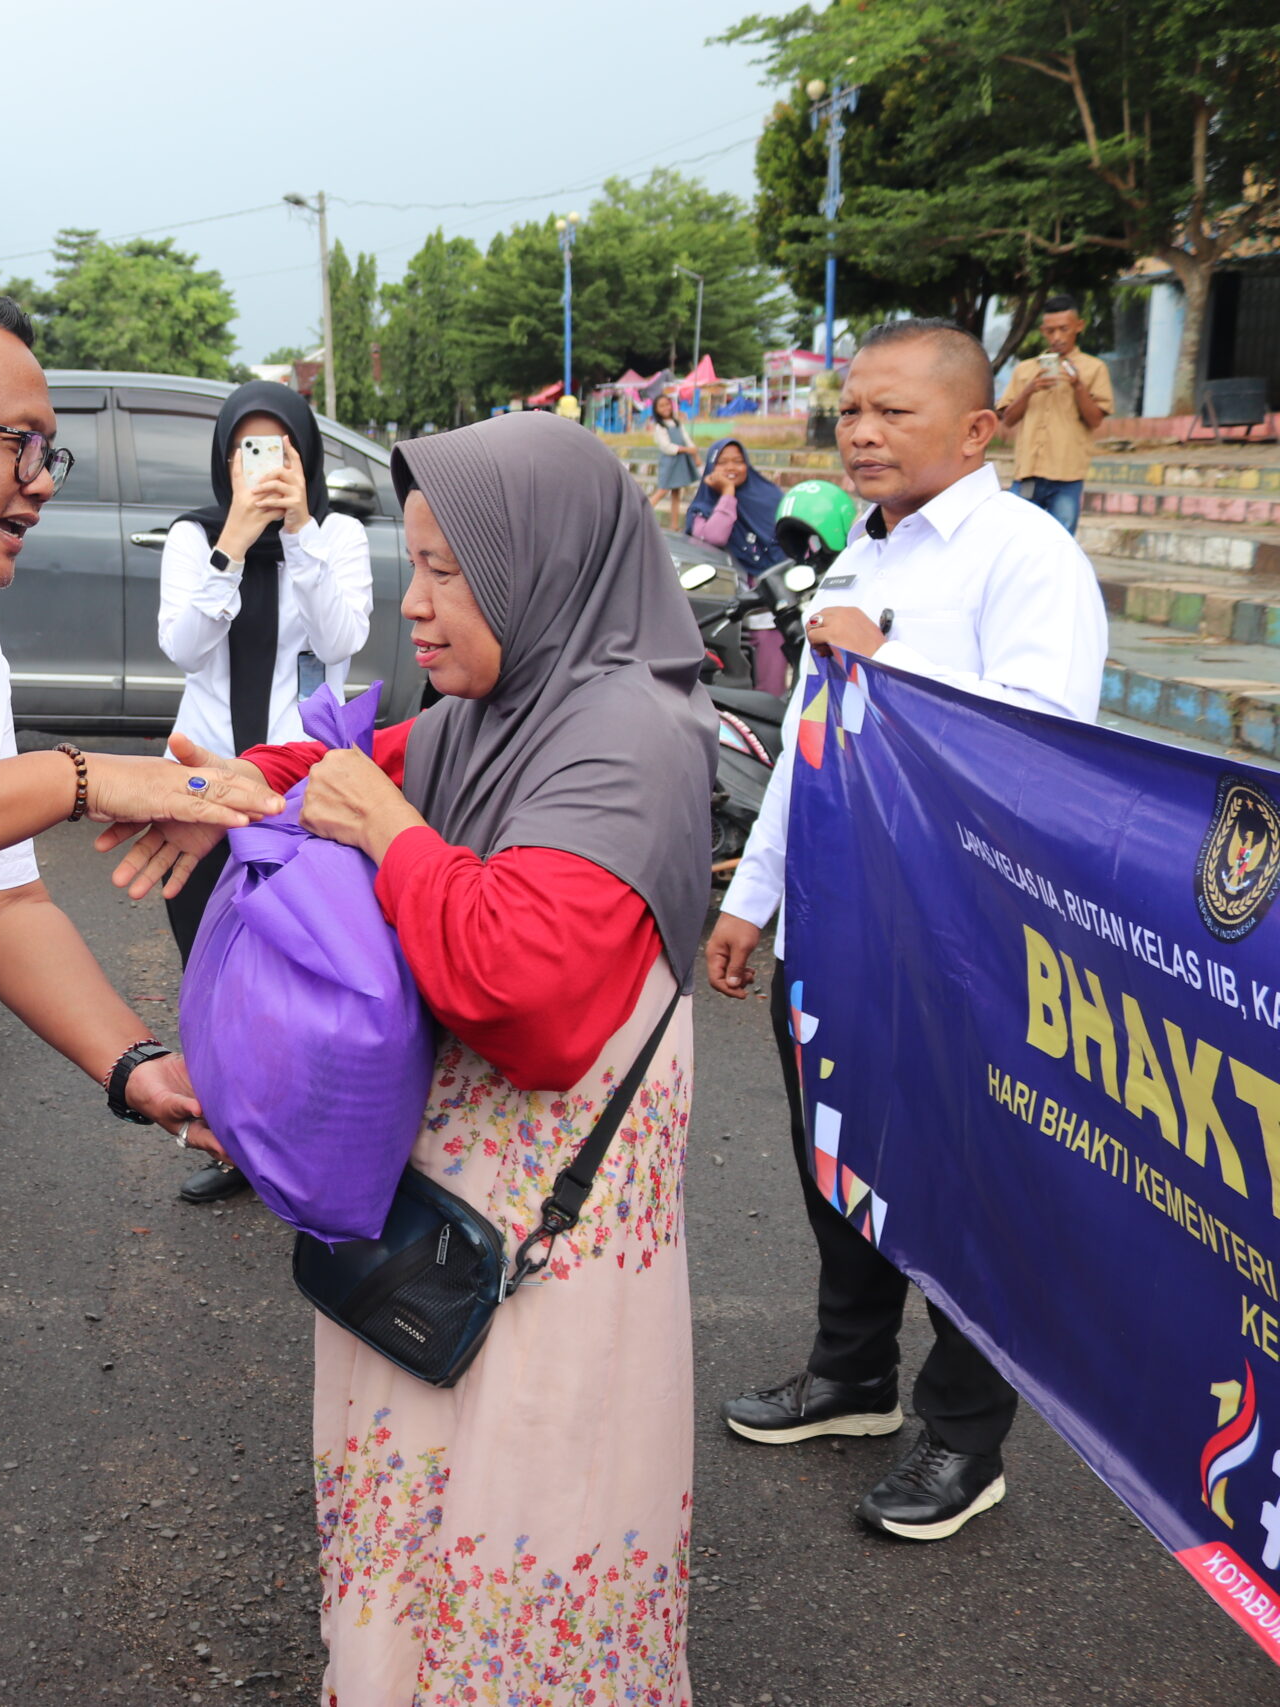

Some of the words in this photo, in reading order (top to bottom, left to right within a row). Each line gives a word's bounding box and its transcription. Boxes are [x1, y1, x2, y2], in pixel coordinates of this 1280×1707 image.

[955, 820, 997, 870] LAPAS
[990, 846, 1039, 900] KELAS
[1036, 873, 1067, 923] IIA,
[1064, 888, 1128, 952] RUTAN
[1129, 921, 1202, 991] KELAS
[1206, 958, 1247, 1021] IIB,
[1220, 916, 1257, 940] INDONESIA
[987, 1063, 1037, 1125] HARI
[1039, 1096, 1128, 1185] BHAKTI
[1134, 1155, 1279, 1303] KEMENTERI
[1240, 1294, 1280, 1363] KE
